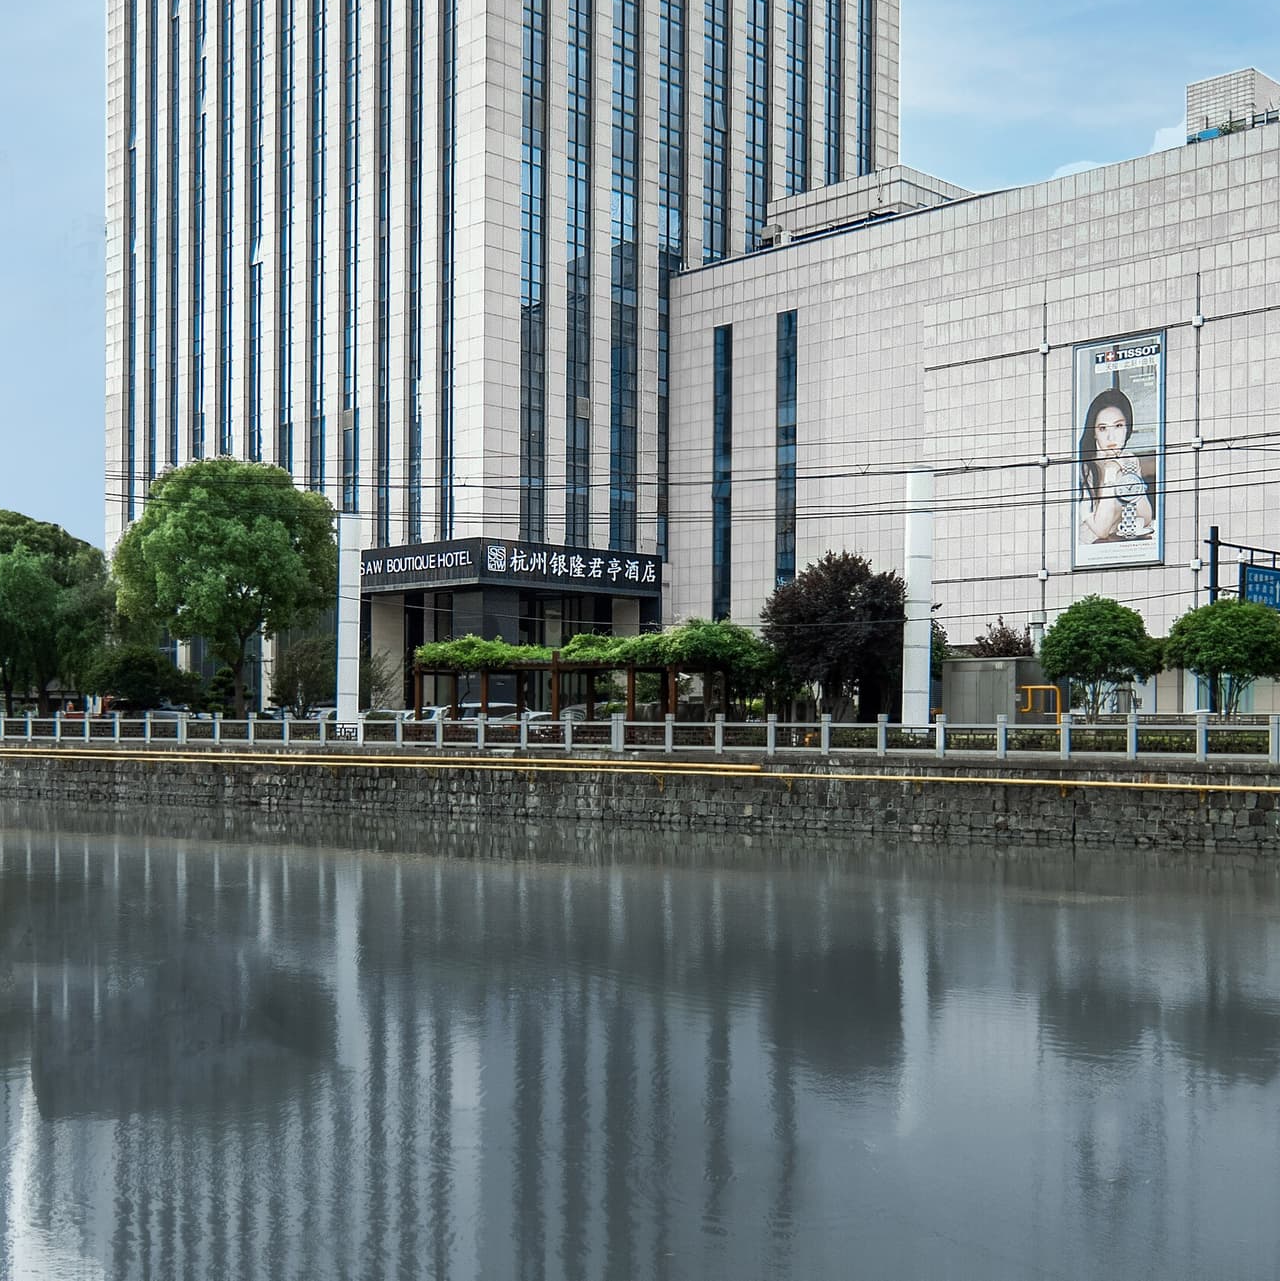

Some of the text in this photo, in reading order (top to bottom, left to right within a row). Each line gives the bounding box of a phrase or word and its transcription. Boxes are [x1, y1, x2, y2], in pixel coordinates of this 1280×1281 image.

[1116, 345, 1159, 359] TISSOT
[386, 553, 436, 574] BOUTIQUE
[437, 550, 473, 568] HOTEL
[509, 547, 657, 584] 杭州银隆君亭酒店
